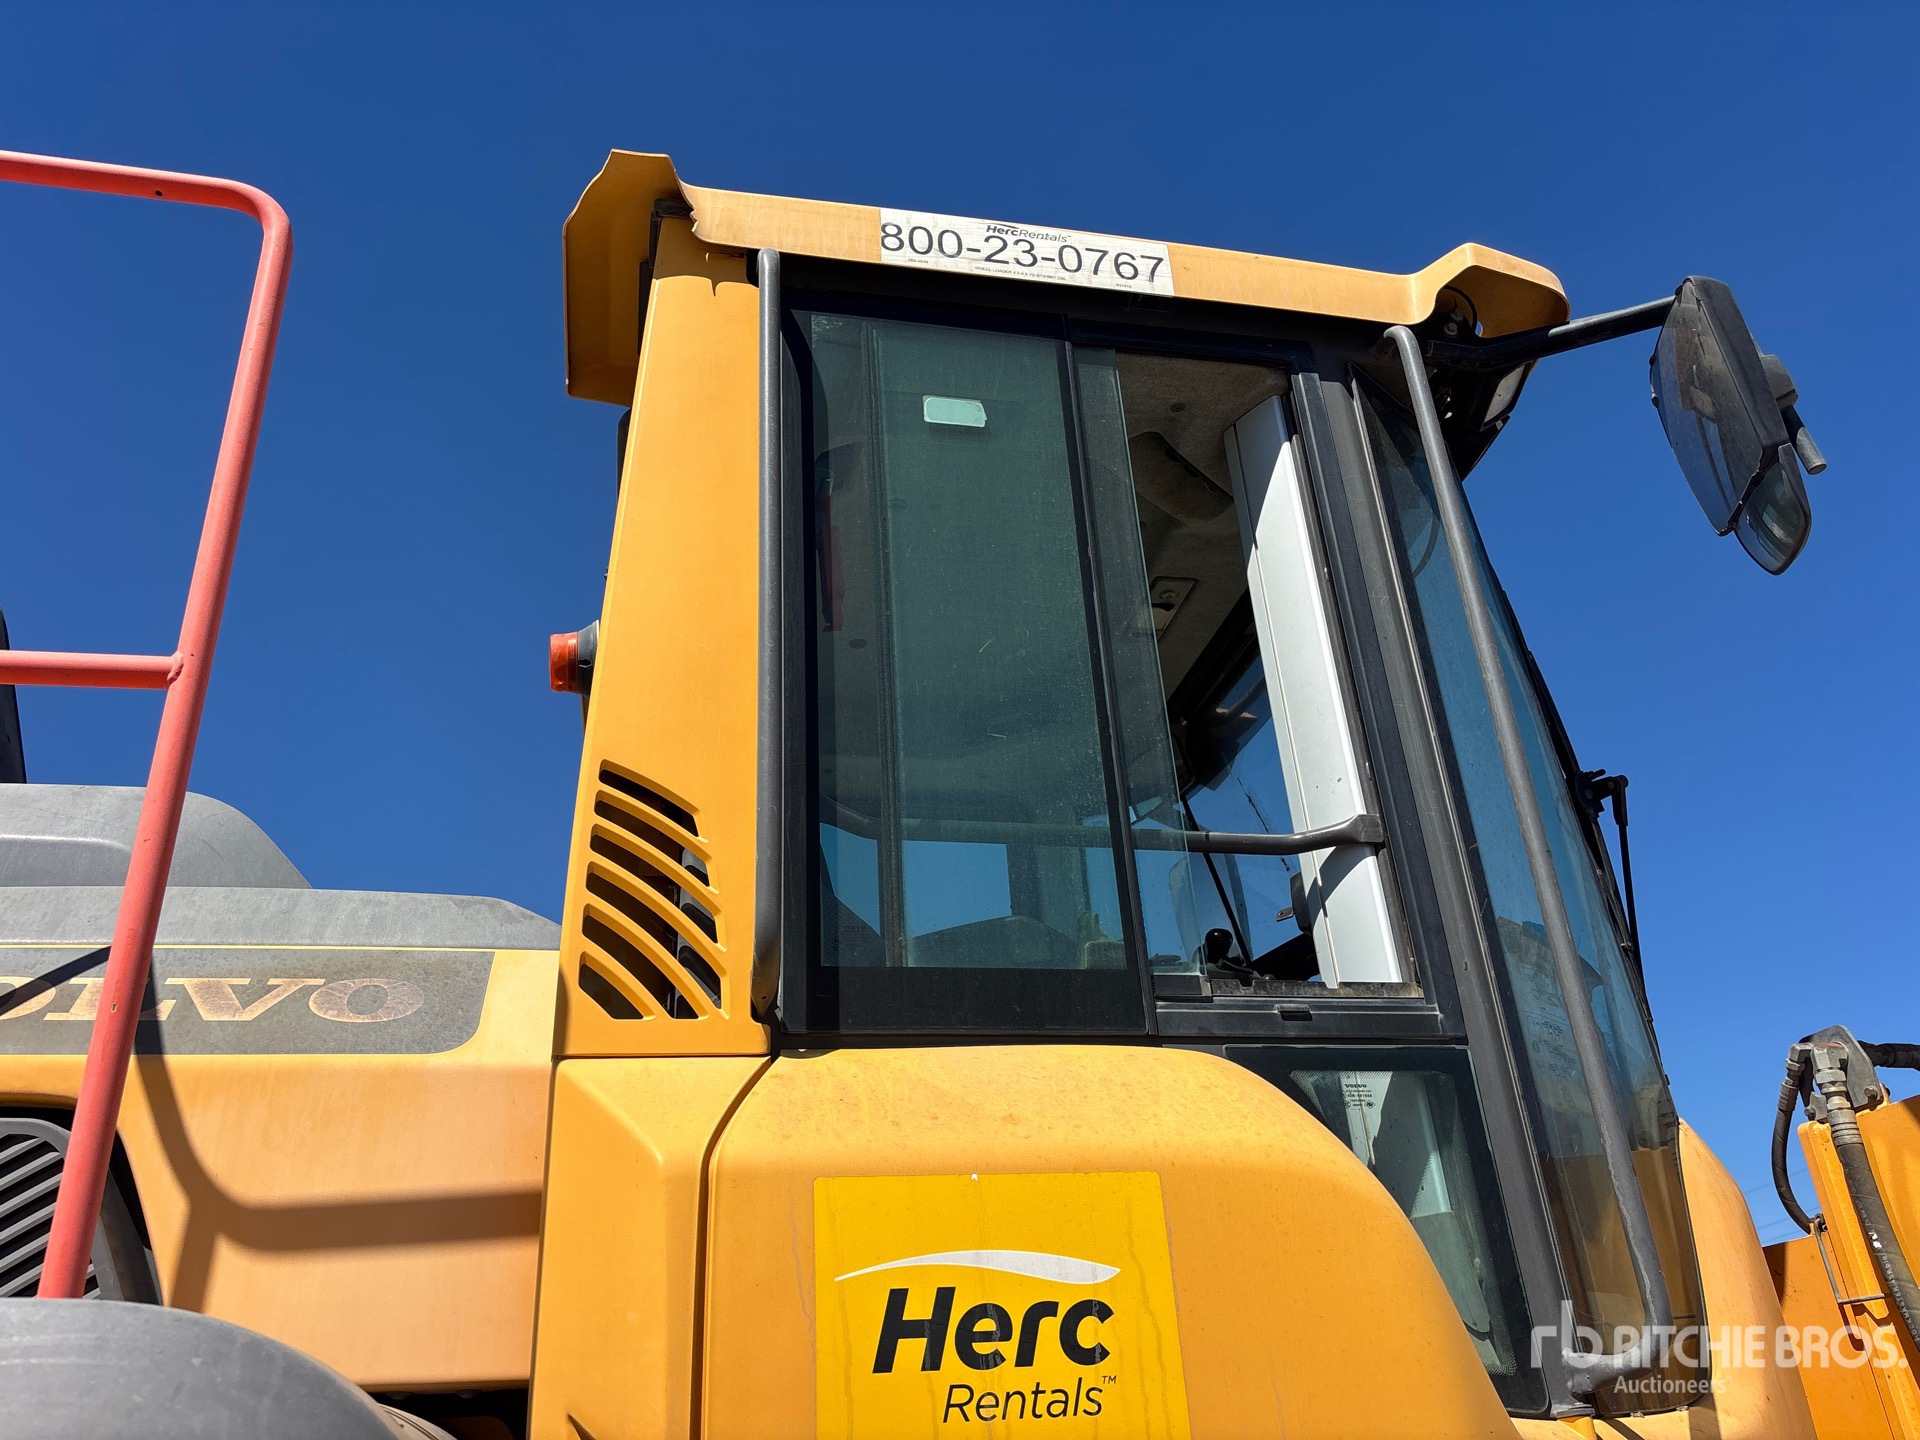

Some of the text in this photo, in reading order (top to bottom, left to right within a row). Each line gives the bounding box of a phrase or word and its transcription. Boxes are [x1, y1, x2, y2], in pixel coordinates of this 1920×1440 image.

[880, 222, 1164, 283] 800-23-0767
[872, 1286, 1115, 1374] Herc
[943, 1377, 1103, 1423] Rentals
